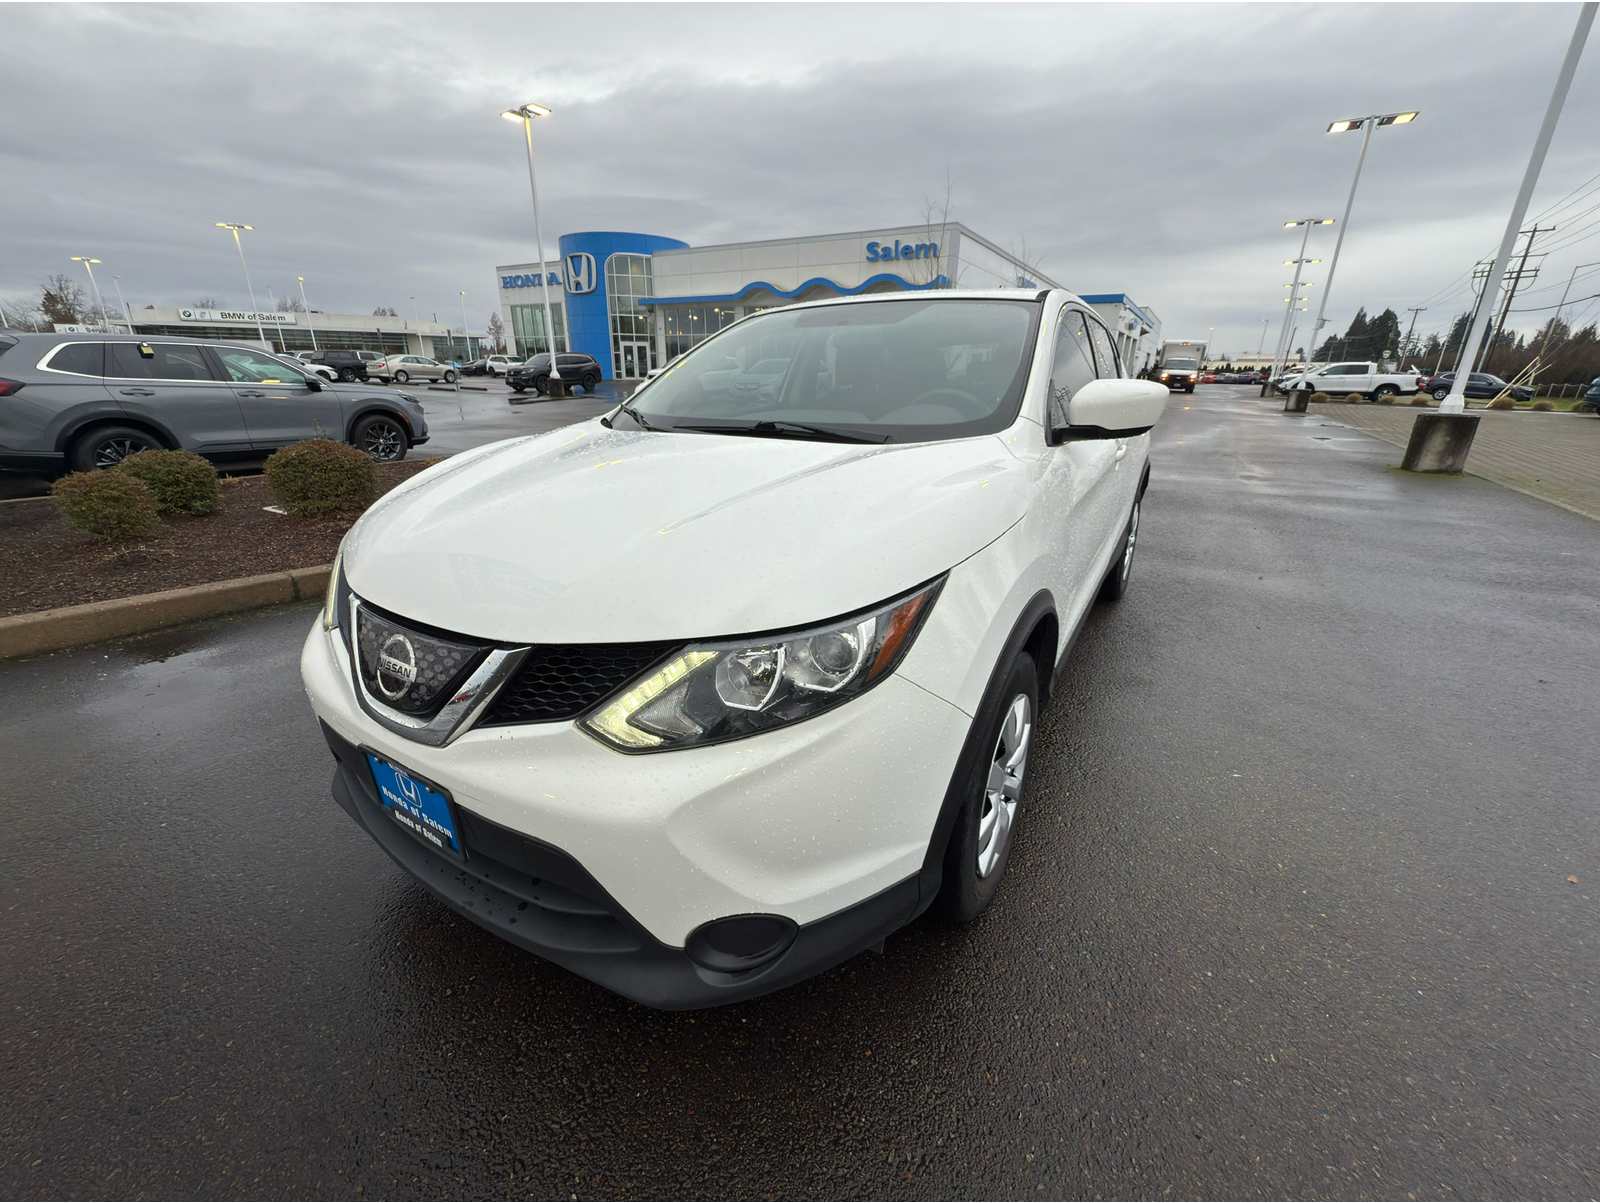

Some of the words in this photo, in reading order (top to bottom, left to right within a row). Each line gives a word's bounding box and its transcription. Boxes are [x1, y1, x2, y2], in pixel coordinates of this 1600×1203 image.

[866, 239, 939, 263] Salem
[219, 311, 246, 320] BMW
[247, 312, 257, 321] of
[257, 313, 286, 321] Salem
[380, 656, 412, 679] NISSAN
